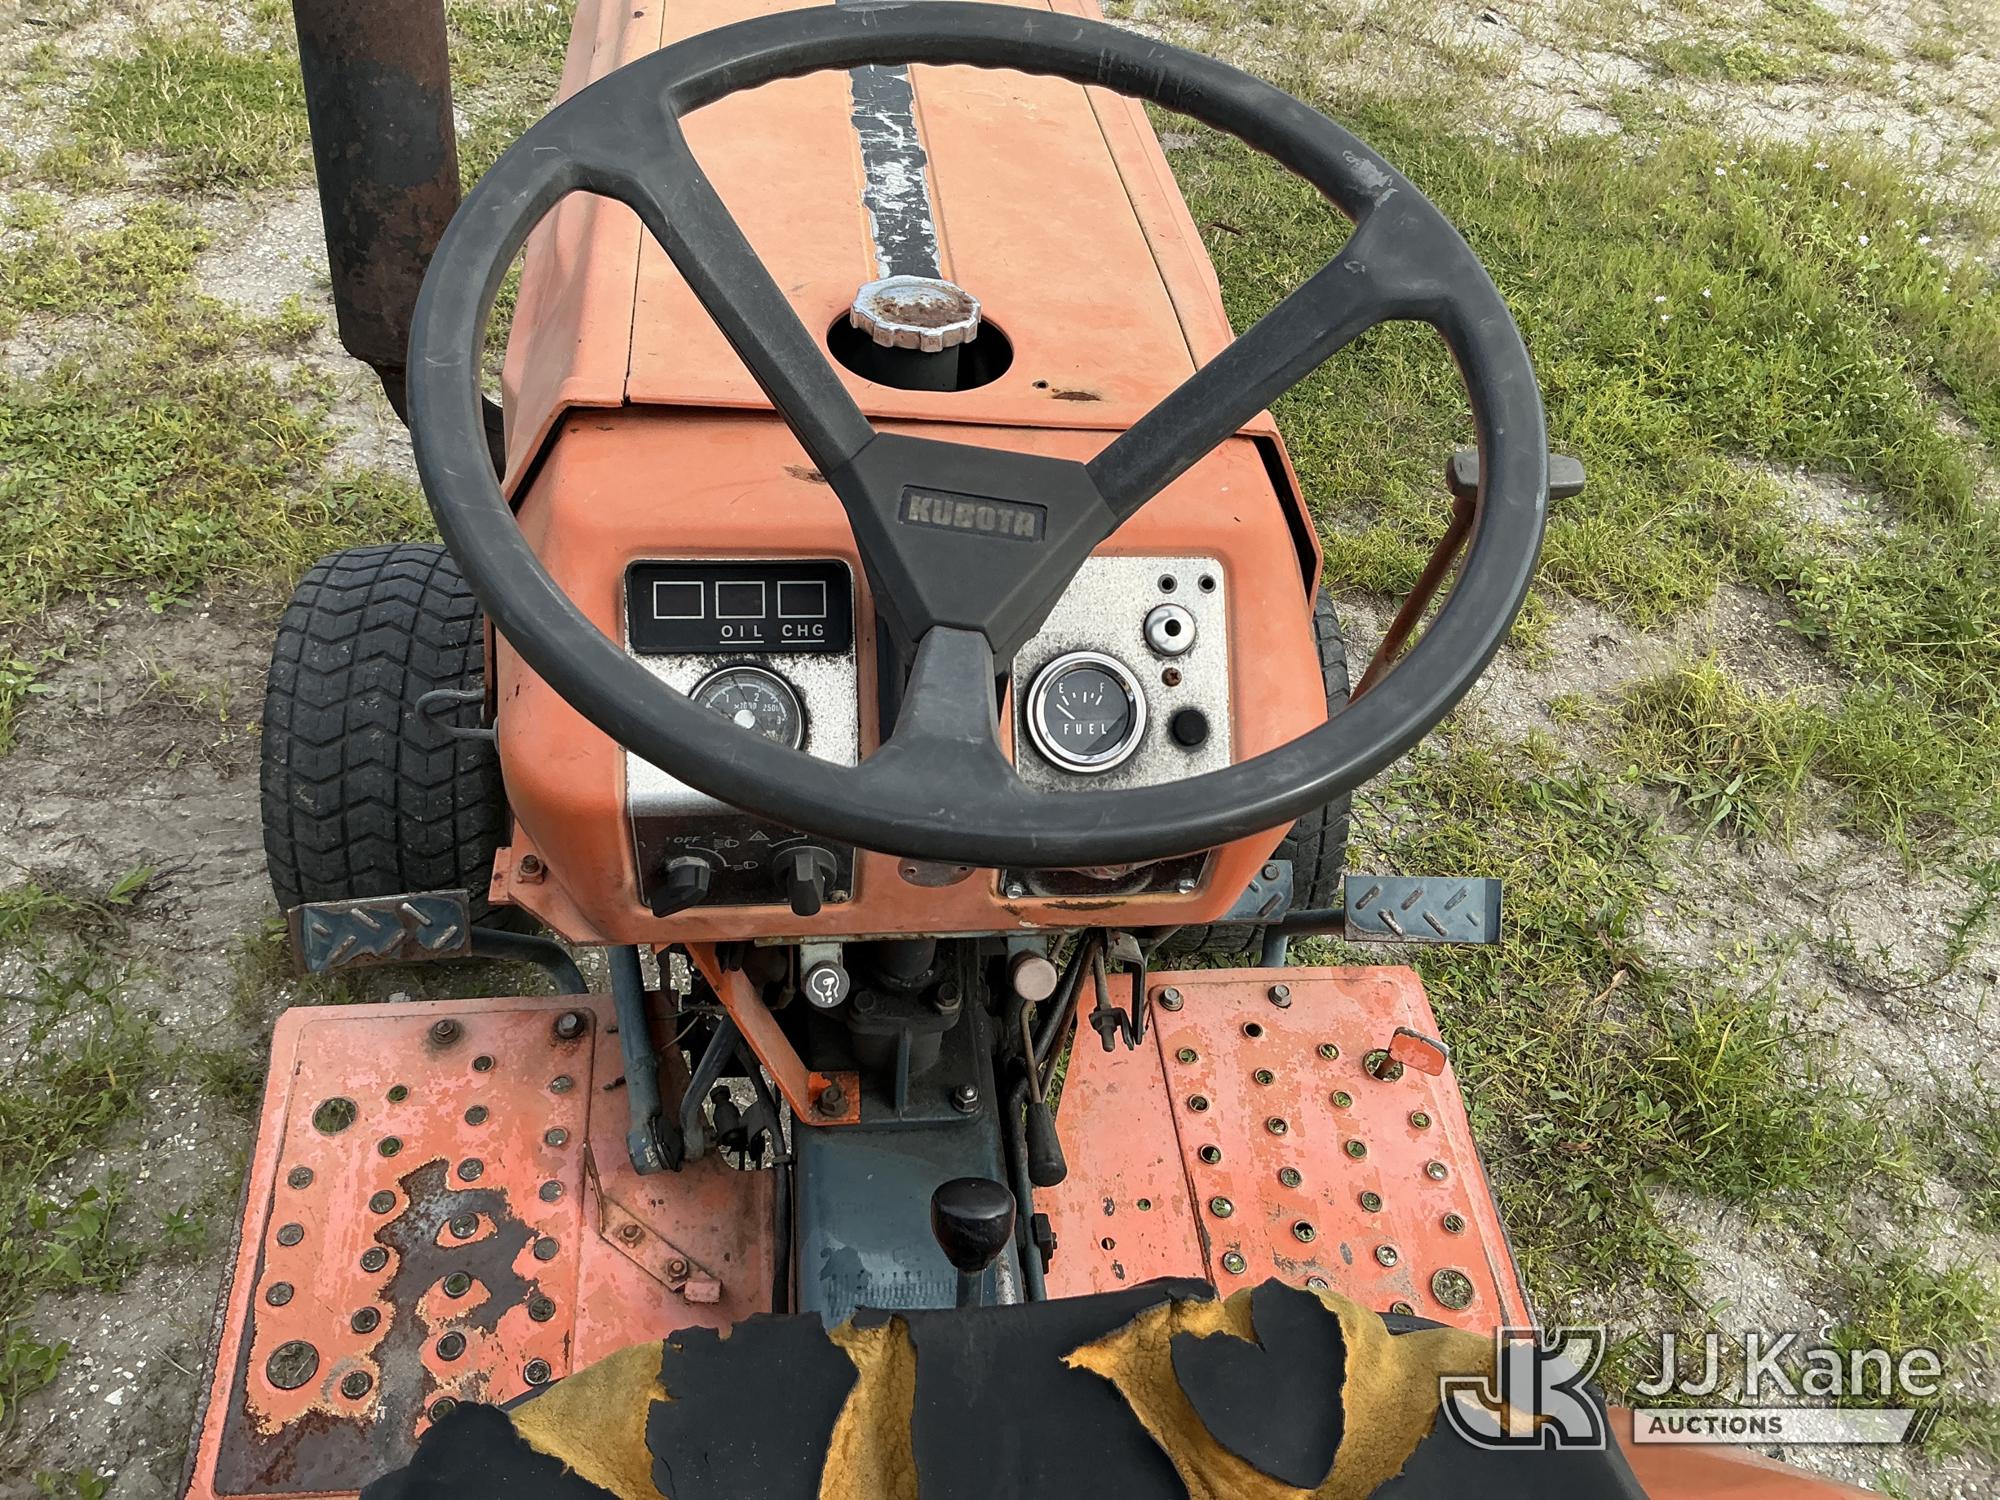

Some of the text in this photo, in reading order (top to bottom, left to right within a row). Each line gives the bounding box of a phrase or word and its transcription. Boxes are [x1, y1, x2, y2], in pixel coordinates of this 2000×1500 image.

[908, 495, 1036, 538] KUBOTA
[721, 624, 824, 638] OIL CHG
[1058, 682, 1064, 694] E
[1064, 723, 1107, 735] FUEL
[673, 836, 701, 844] OFF
